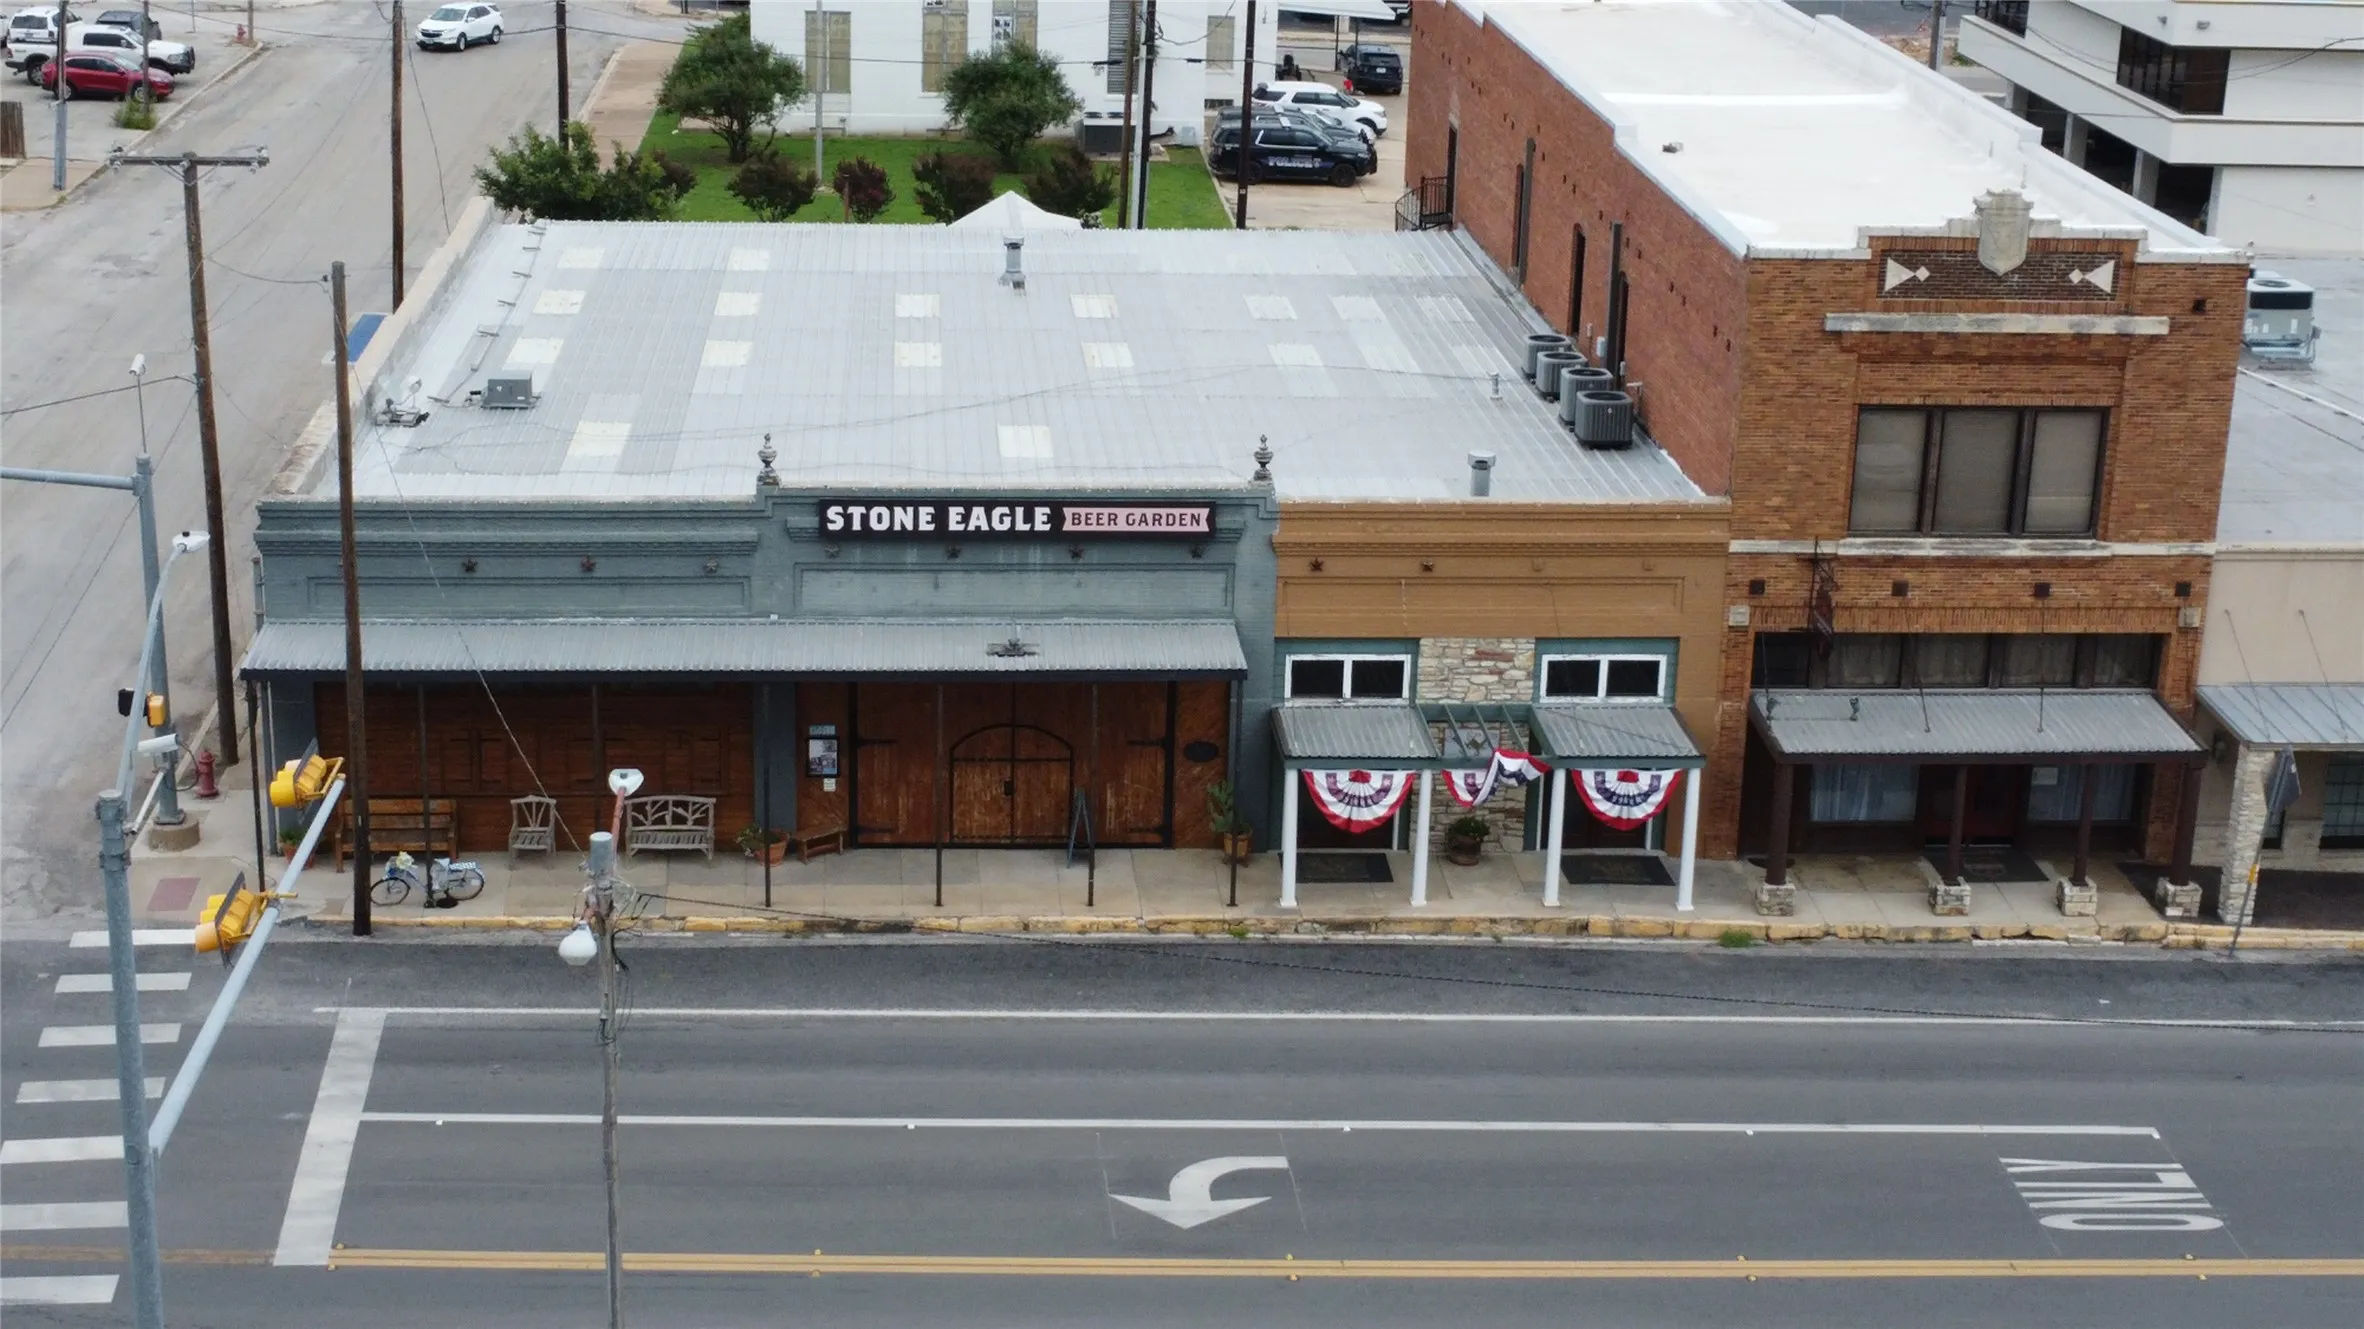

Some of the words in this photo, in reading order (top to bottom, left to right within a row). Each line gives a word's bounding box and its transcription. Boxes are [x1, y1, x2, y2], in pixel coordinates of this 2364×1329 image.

[826, 505, 935, 532] STONE
[948, 505, 1052, 532] EAGLE
[1071, 511, 1119, 527] BEER
[1125, 511, 1202, 528] GARDEN
[1999, 1157, 2224, 1231] ONLY
